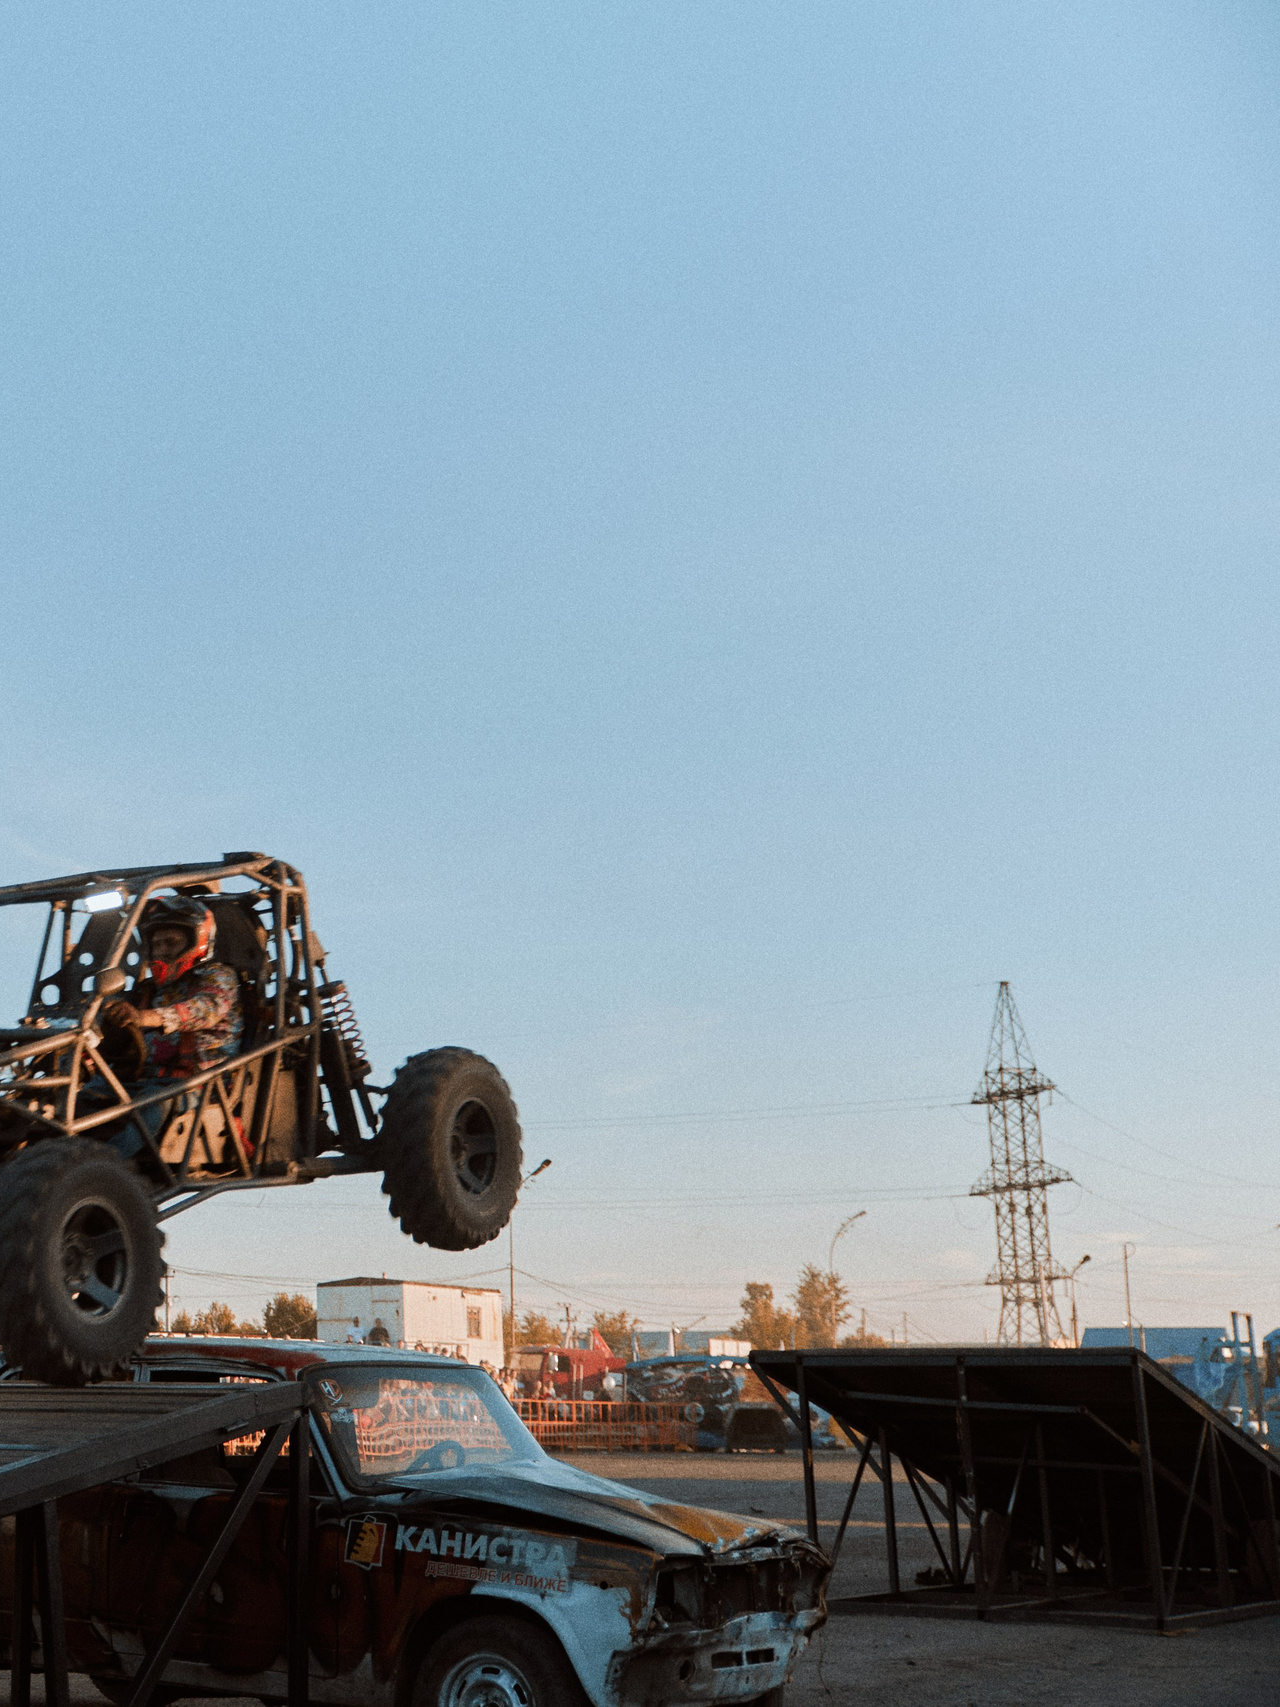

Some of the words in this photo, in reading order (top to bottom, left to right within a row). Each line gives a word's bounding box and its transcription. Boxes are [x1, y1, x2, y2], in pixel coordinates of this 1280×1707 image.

[395, 1524, 567, 1567] КАНИСТРА
[425, 1560, 497, 1583] ДЕШЕВЛЕ
[501, 1571, 512, 1583] И
[514, 1574, 567, 1593] БЛИЖЕ
